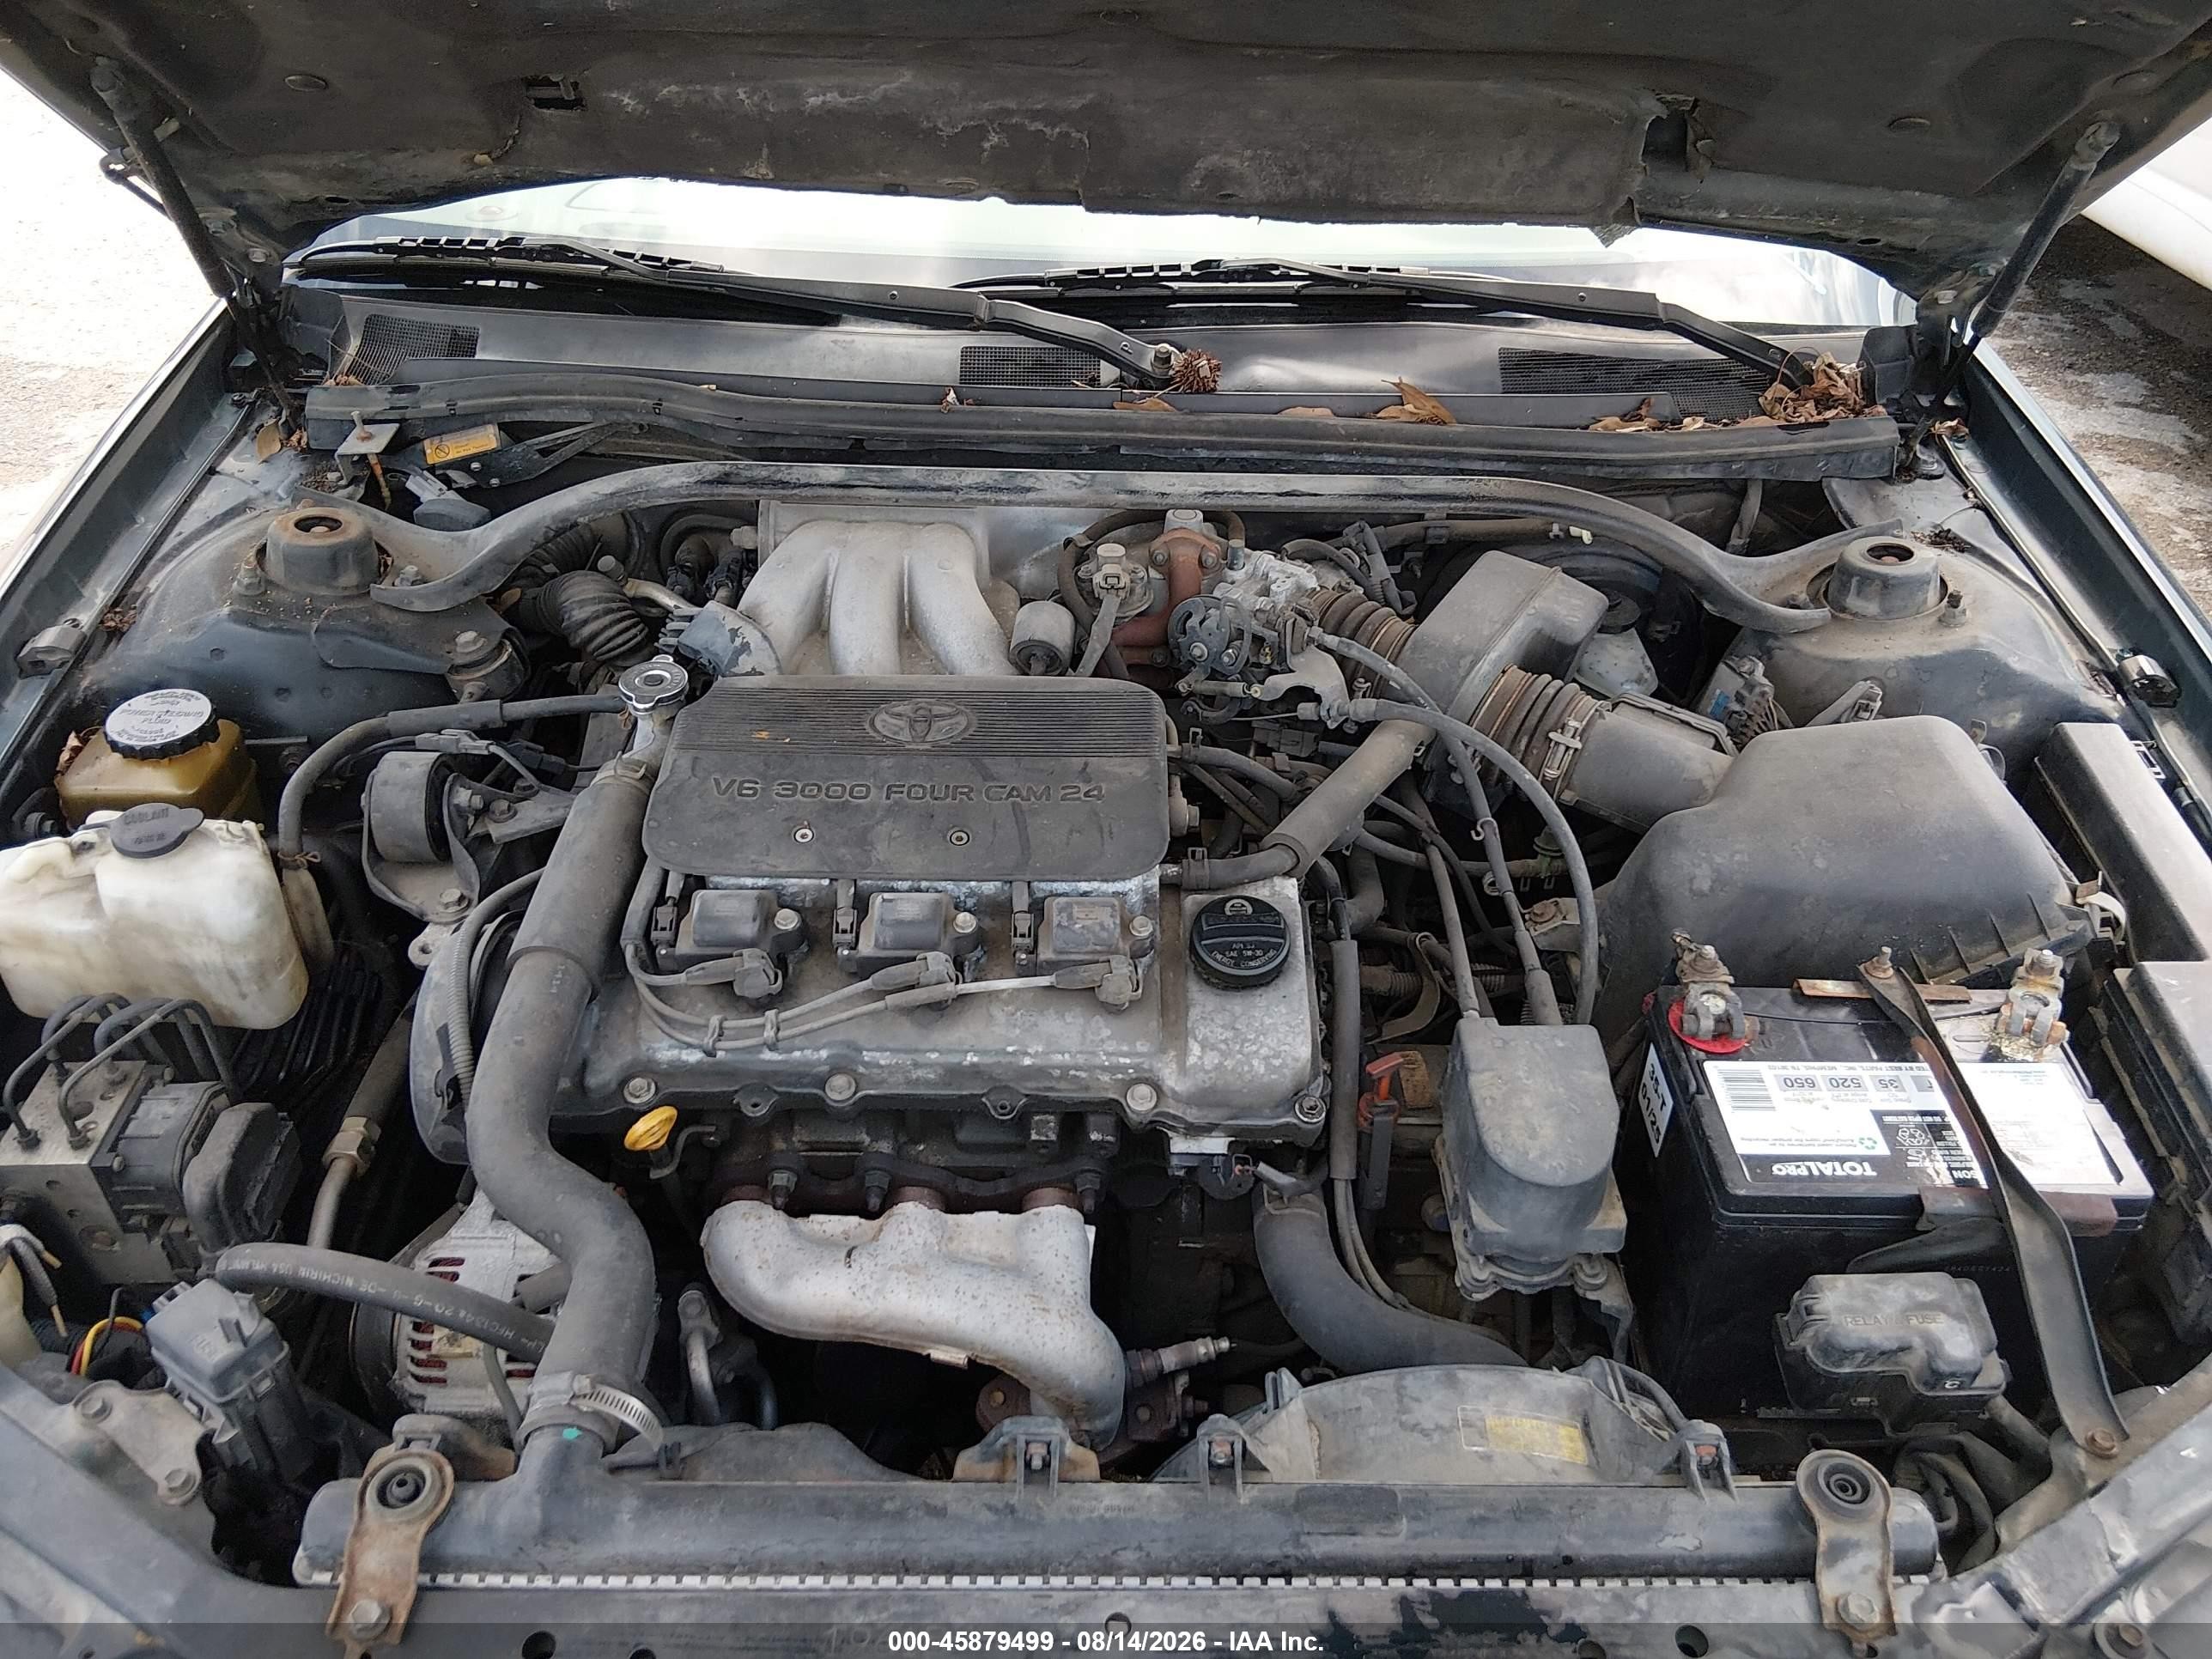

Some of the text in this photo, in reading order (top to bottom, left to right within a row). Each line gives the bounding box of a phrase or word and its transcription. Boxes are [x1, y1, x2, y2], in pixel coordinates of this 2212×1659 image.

[713, 777, 1105, 803] V6 3000 FOUR CAM 24
[1211, 949, 1277, 968] ENERGY CONSERVING
[1783, 1077, 1817, 1089] 650
[1828, 1077, 1863, 1089] 520
[1878, 1078, 1899, 1090] 35
[1771, 1161, 1878, 1176] TOTALPRO
[1953, 1170, 1979, 1179] SON
[271, 1262, 293, 1274] USA
[298, 1265, 355, 1287] NICHIRIN
[1844, 1316, 1890, 1327] RELAY
[1905, 1312, 1945, 1326] FUSE
